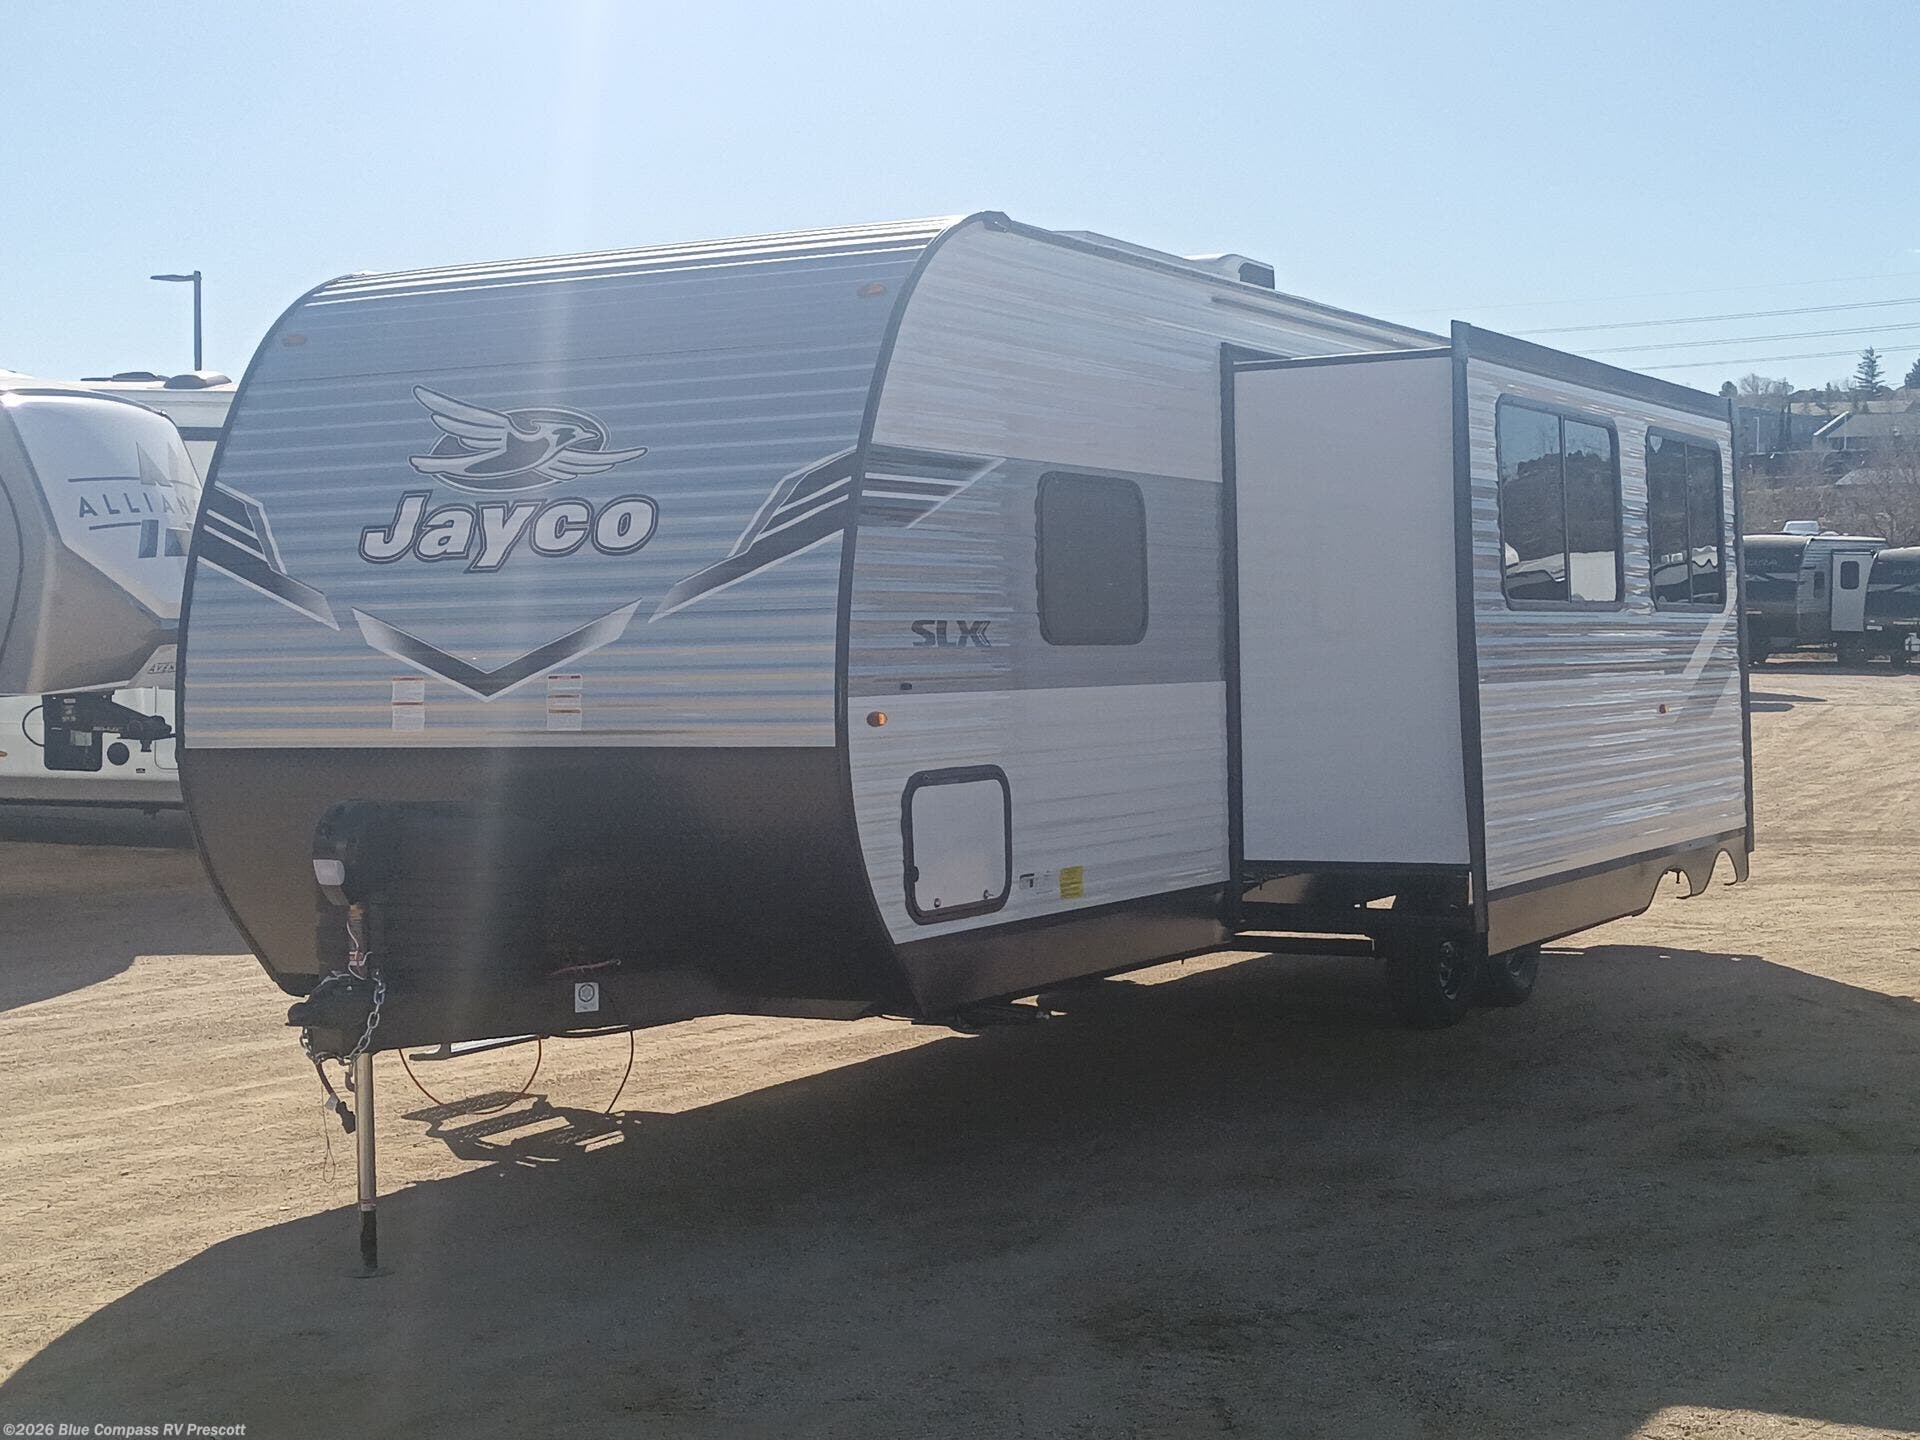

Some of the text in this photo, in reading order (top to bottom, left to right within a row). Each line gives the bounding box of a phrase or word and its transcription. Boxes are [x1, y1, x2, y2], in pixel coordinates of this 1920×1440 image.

[80, 492, 198, 518] ALLIAN
[358, 489, 660, 574] Jayco
[911, 619, 992, 648] SLX
